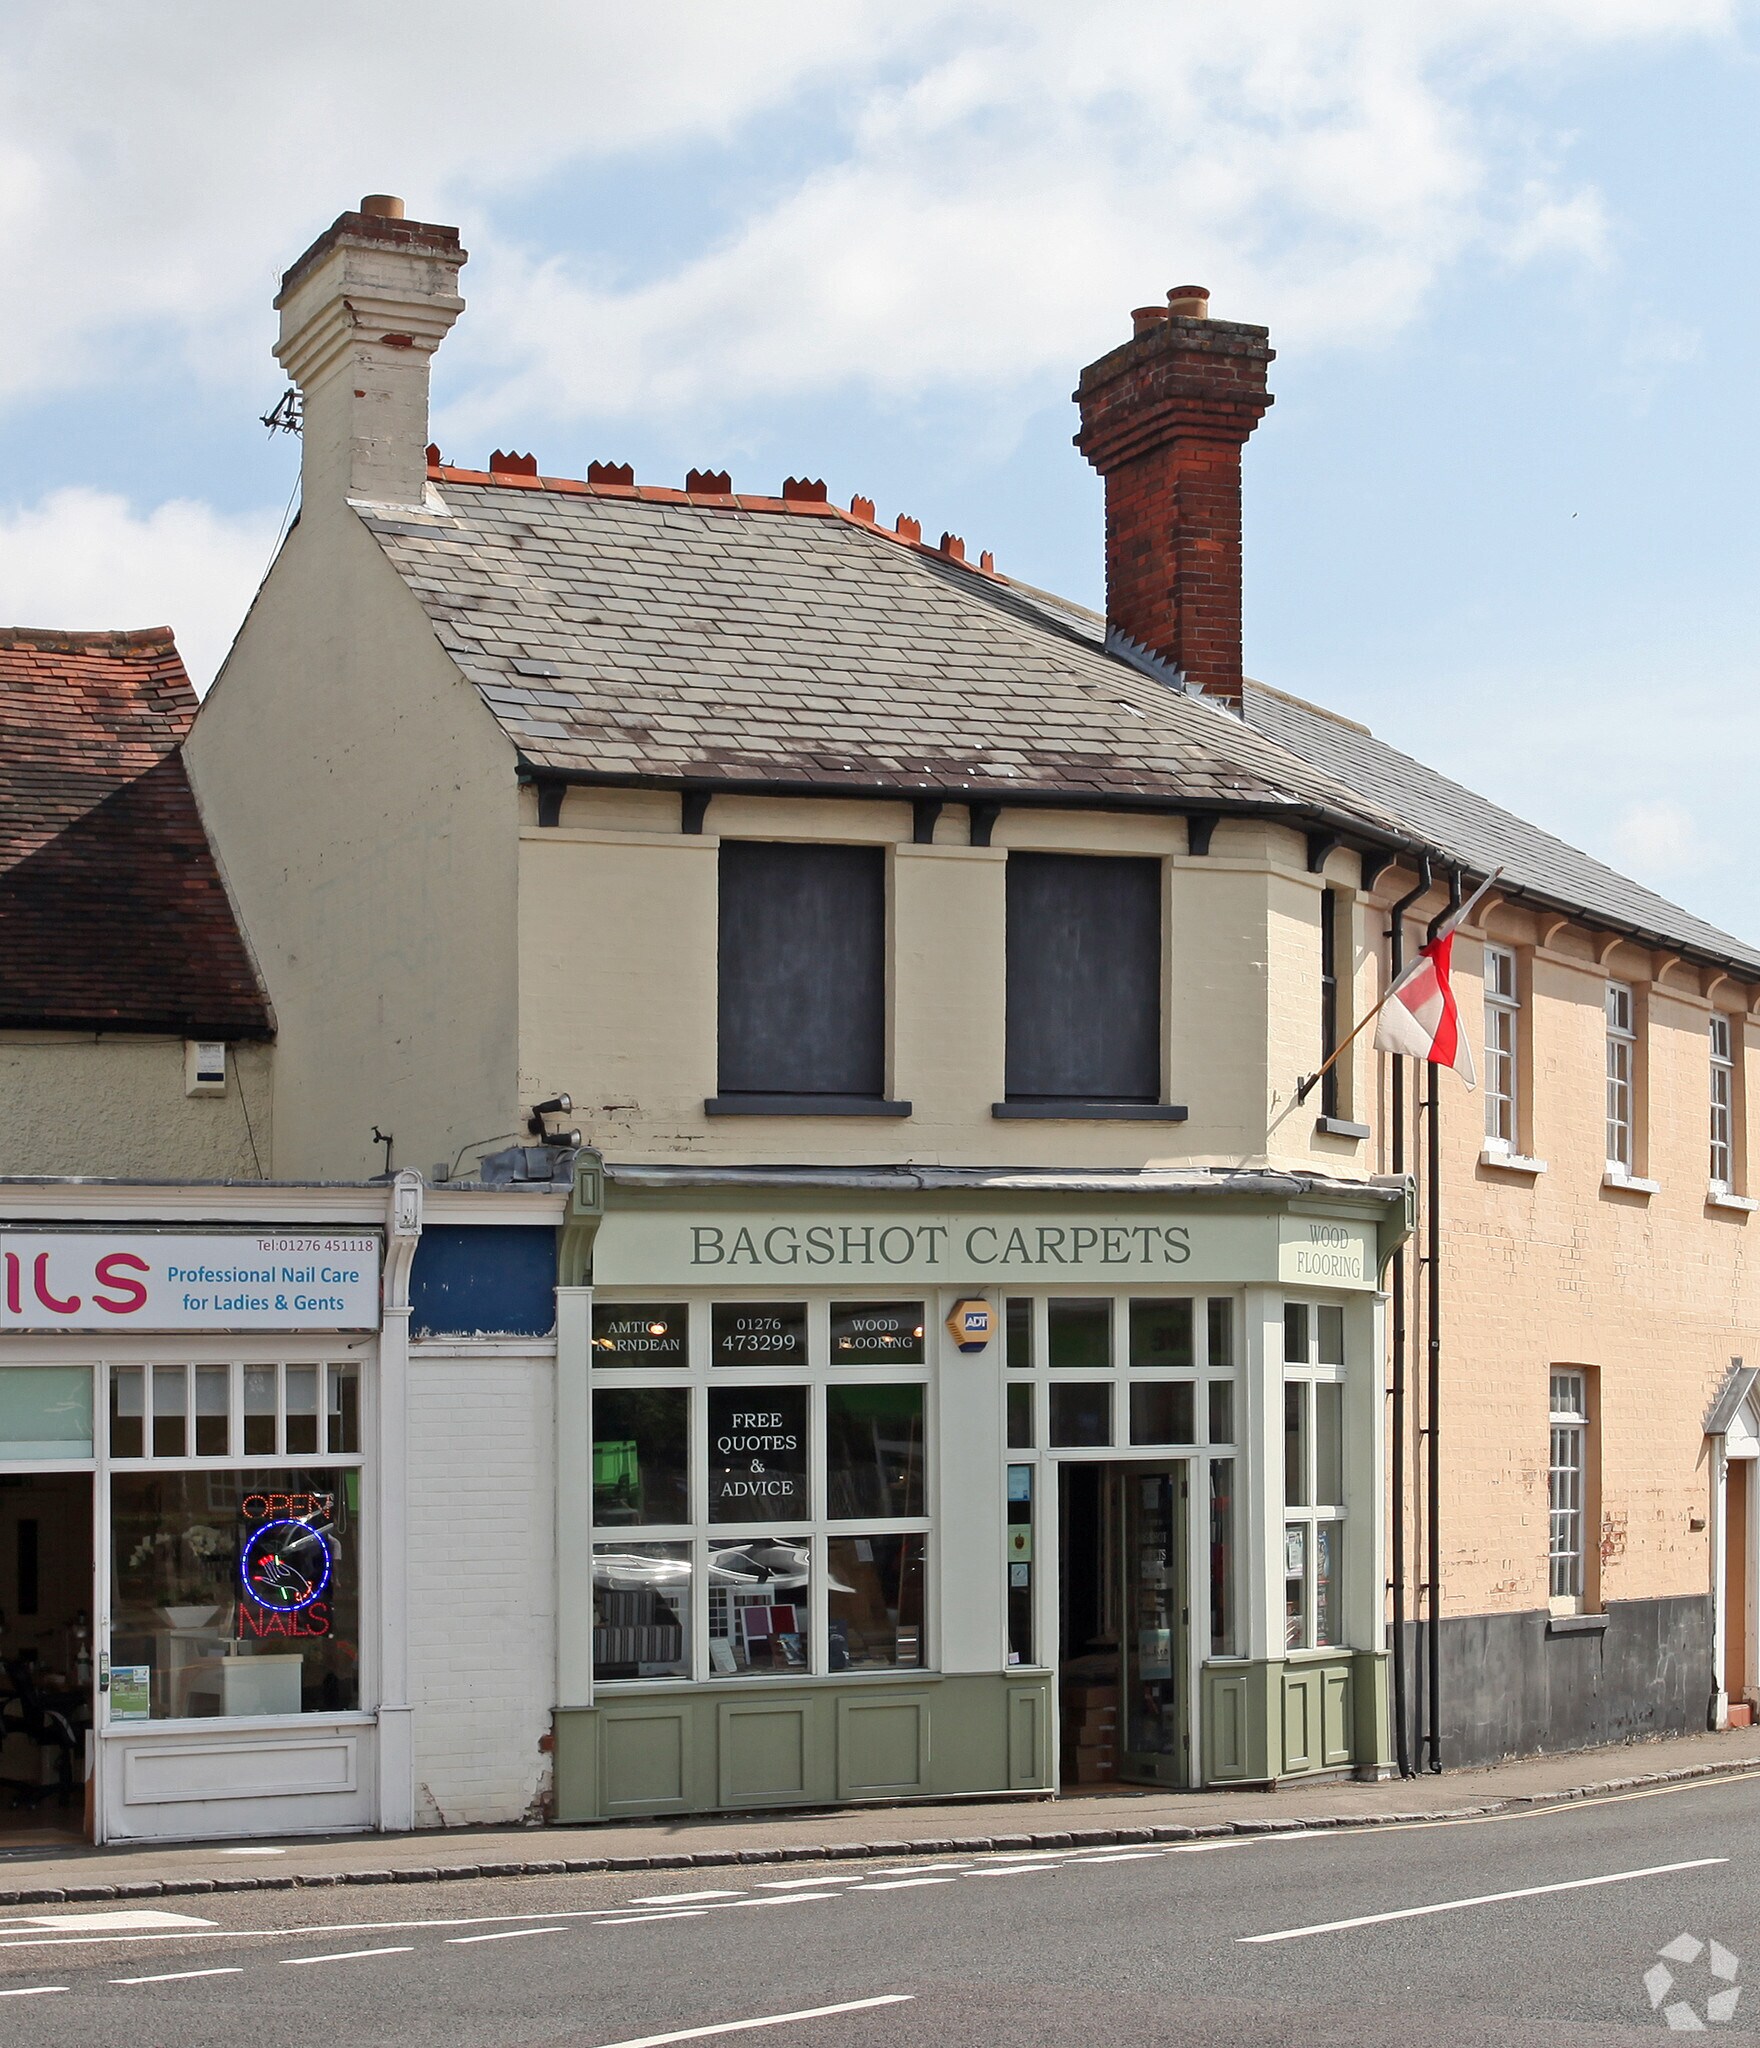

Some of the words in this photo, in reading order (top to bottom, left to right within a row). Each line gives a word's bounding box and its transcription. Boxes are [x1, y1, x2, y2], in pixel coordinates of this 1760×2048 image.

[257, 1239, 321, 1252] Tel:01276
[324, 1239, 374, 1252] 451118
[690, 1226, 948, 1265] BAGSHOT
[965, 1226, 1192, 1265] CARPETS
[1309, 1224, 1349, 1250] WOOD
[1297, 1251, 1360, 1279] FLOORING
[168, 1266, 277, 1283] Professional
[282, 1266, 316, 1283] Nail
[321, 1267, 360, 1283] Care
[183, 1294, 209, 1311] for
[214, 1294, 269, 1311] Ladies
[275, 1295, 289, 1311] &
[294, 1295, 345, 1311] Gents
[736, 1318, 782, 1331] 01276
[852, 1319, 899, 1332] WOOD
[965, 1315, 988, 1328] ADT
[722, 1334, 796, 1351] 473299
[731, 1412, 783, 1429] FREE
[717, 1435, 797, 1455] QUOTES
[750, 1458, 766, 1473] &
[720, 1480, 794, 1497] ADVICE
[242, 1494, 332, 1520] OPEN
[239, 1602, 331, 1639] NAILS
